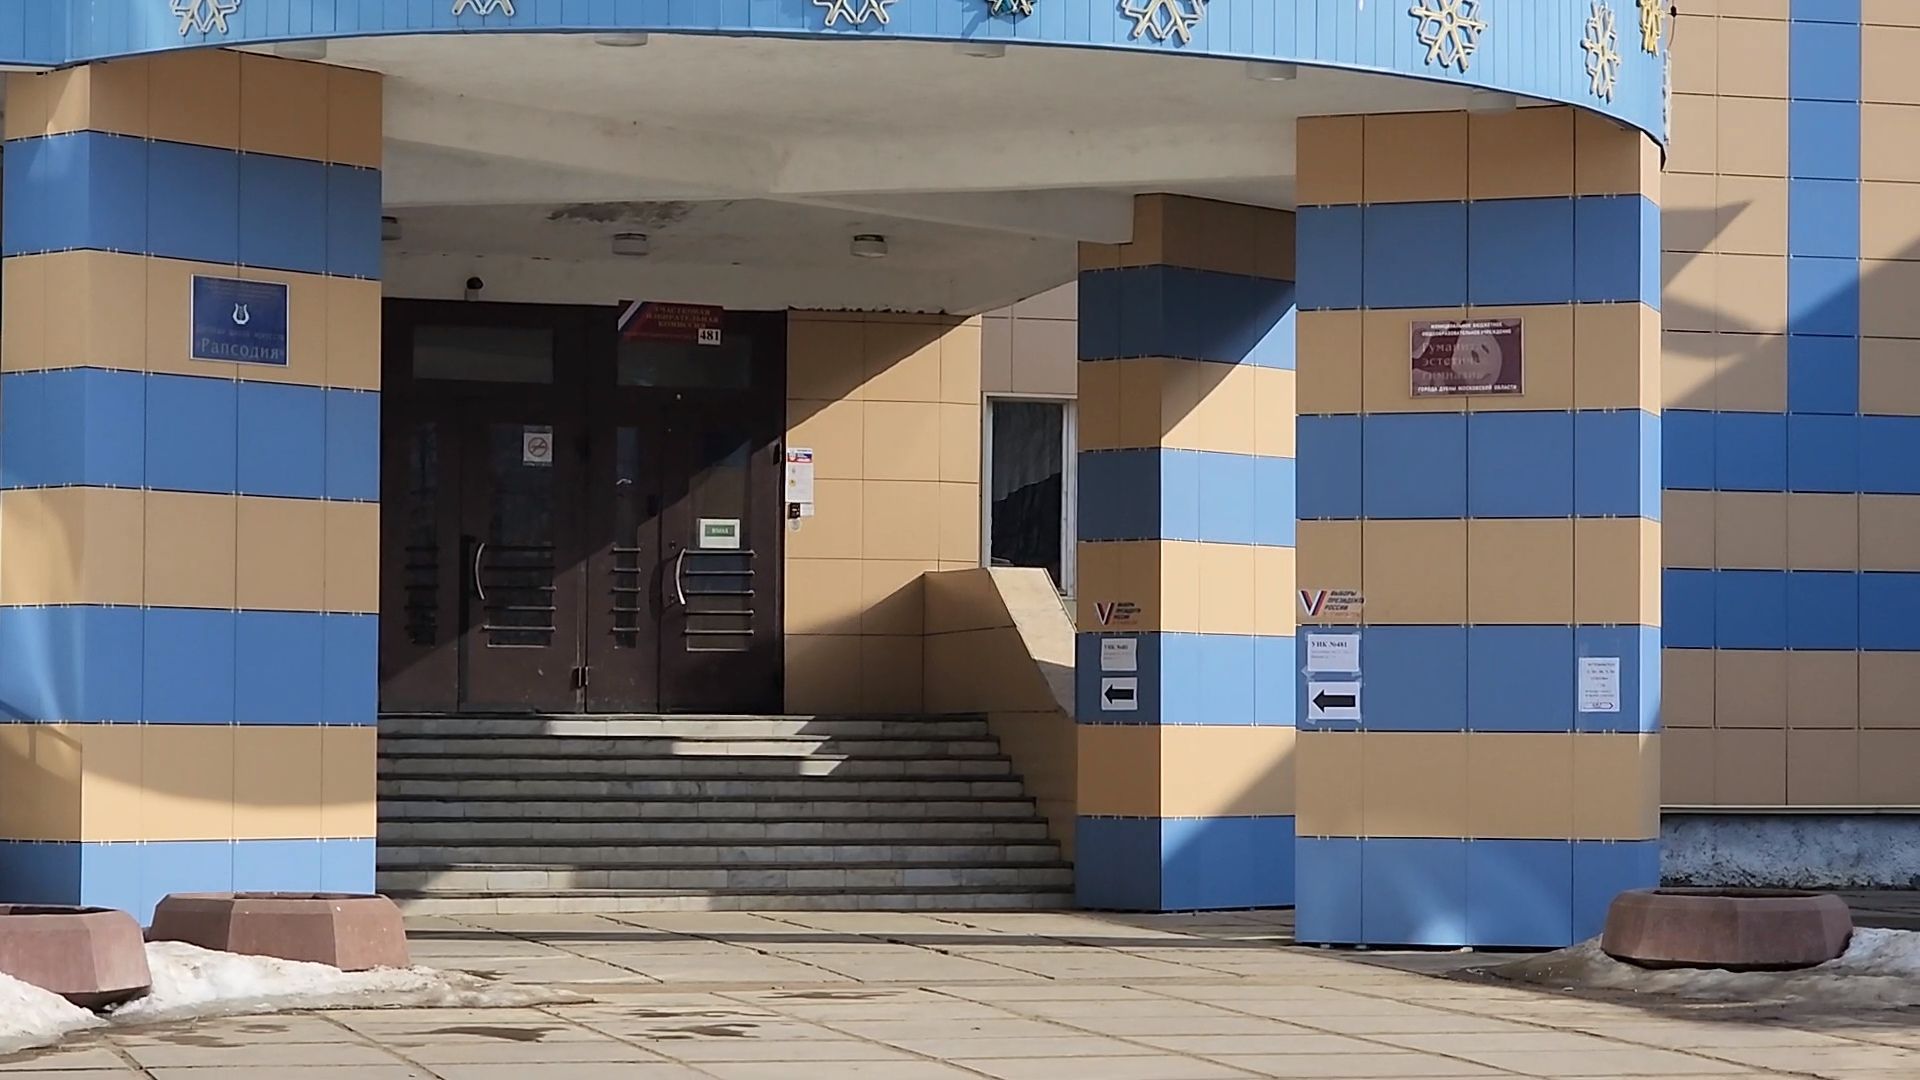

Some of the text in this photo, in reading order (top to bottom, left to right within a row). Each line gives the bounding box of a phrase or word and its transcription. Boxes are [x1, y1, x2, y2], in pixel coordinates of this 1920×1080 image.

[699, 330, 720, 341] 481
[1457, 383, 1492, 392] МОСКОВСКОЙ
[1493, 383, 1518, 391] ОБЛАСТИ
